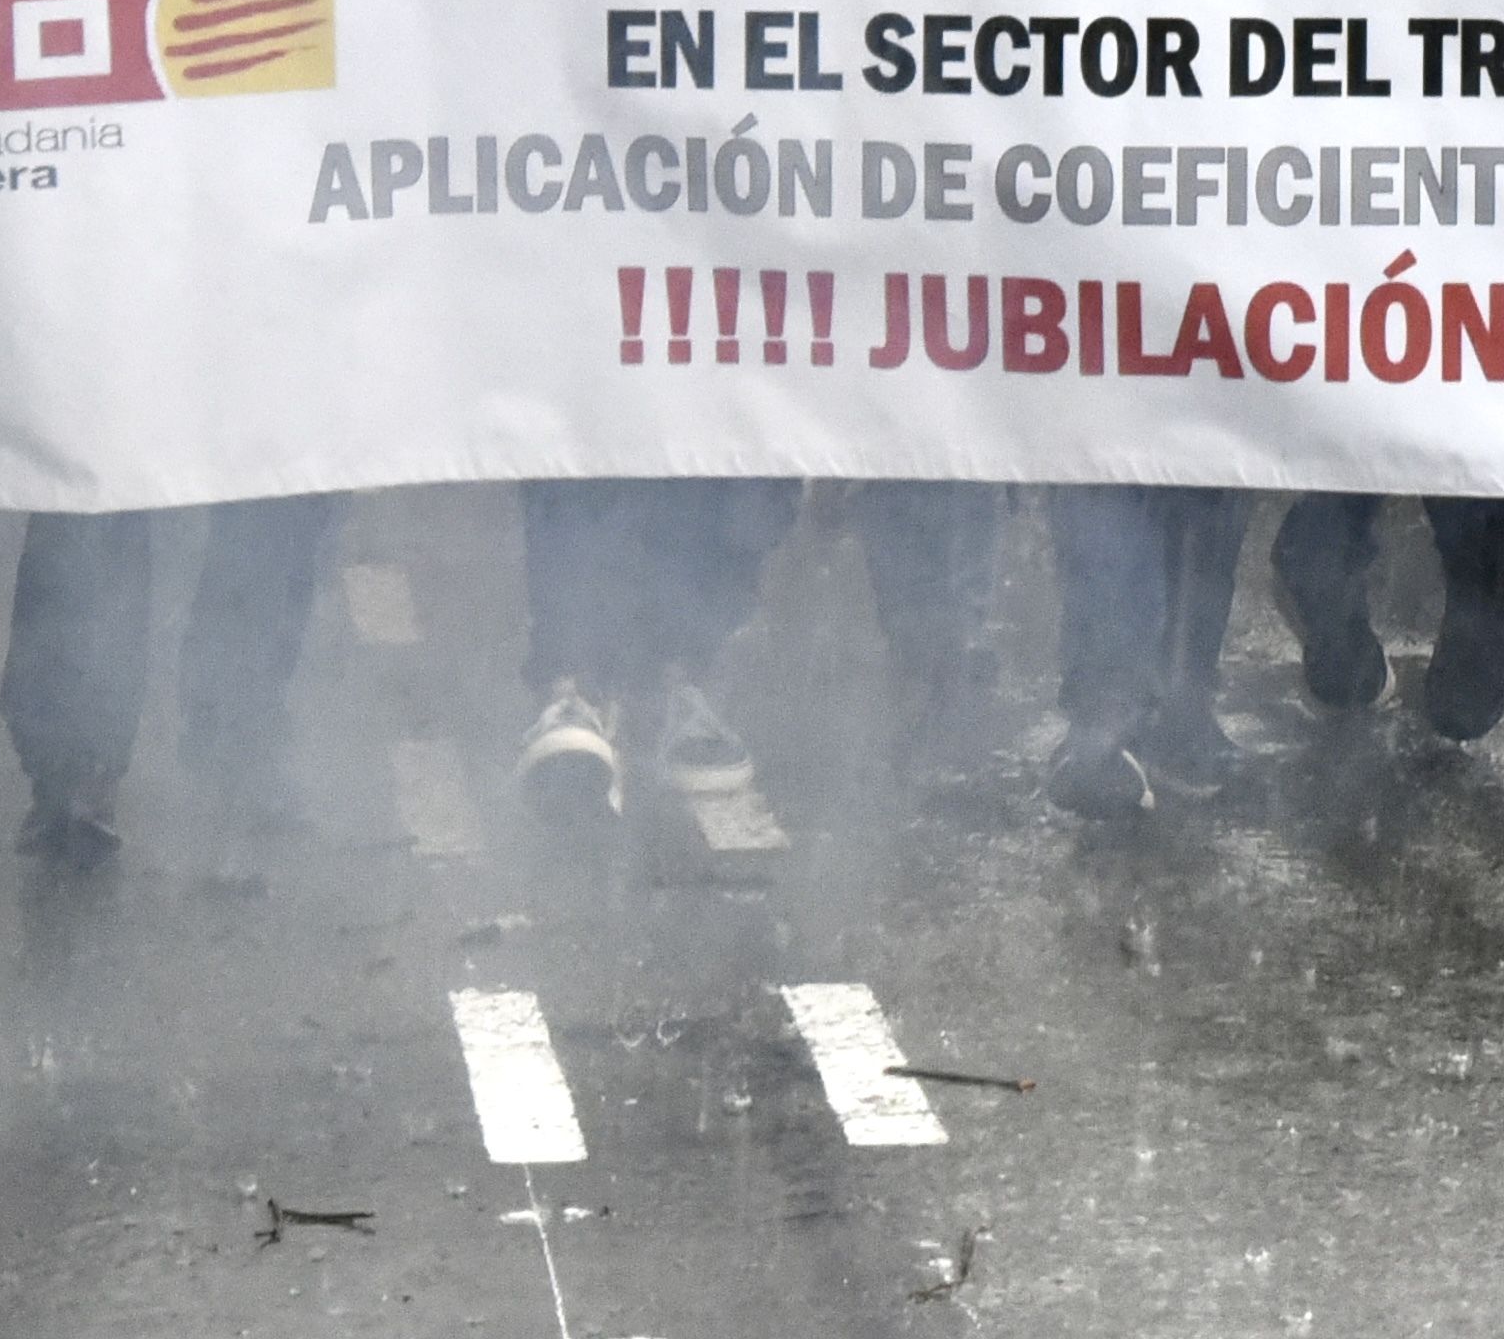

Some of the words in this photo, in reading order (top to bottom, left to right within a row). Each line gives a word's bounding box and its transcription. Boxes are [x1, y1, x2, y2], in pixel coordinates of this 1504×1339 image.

[607, 10, 715, 90] EN
[745, 11, 843, 92] EL
[862, 13, 1202, 99] SECTOR
[1229, 17, 1391, 98] DEL
[308, 113, 833, 223] APLICACIÓN
[861, 140, 974, 222] DE
